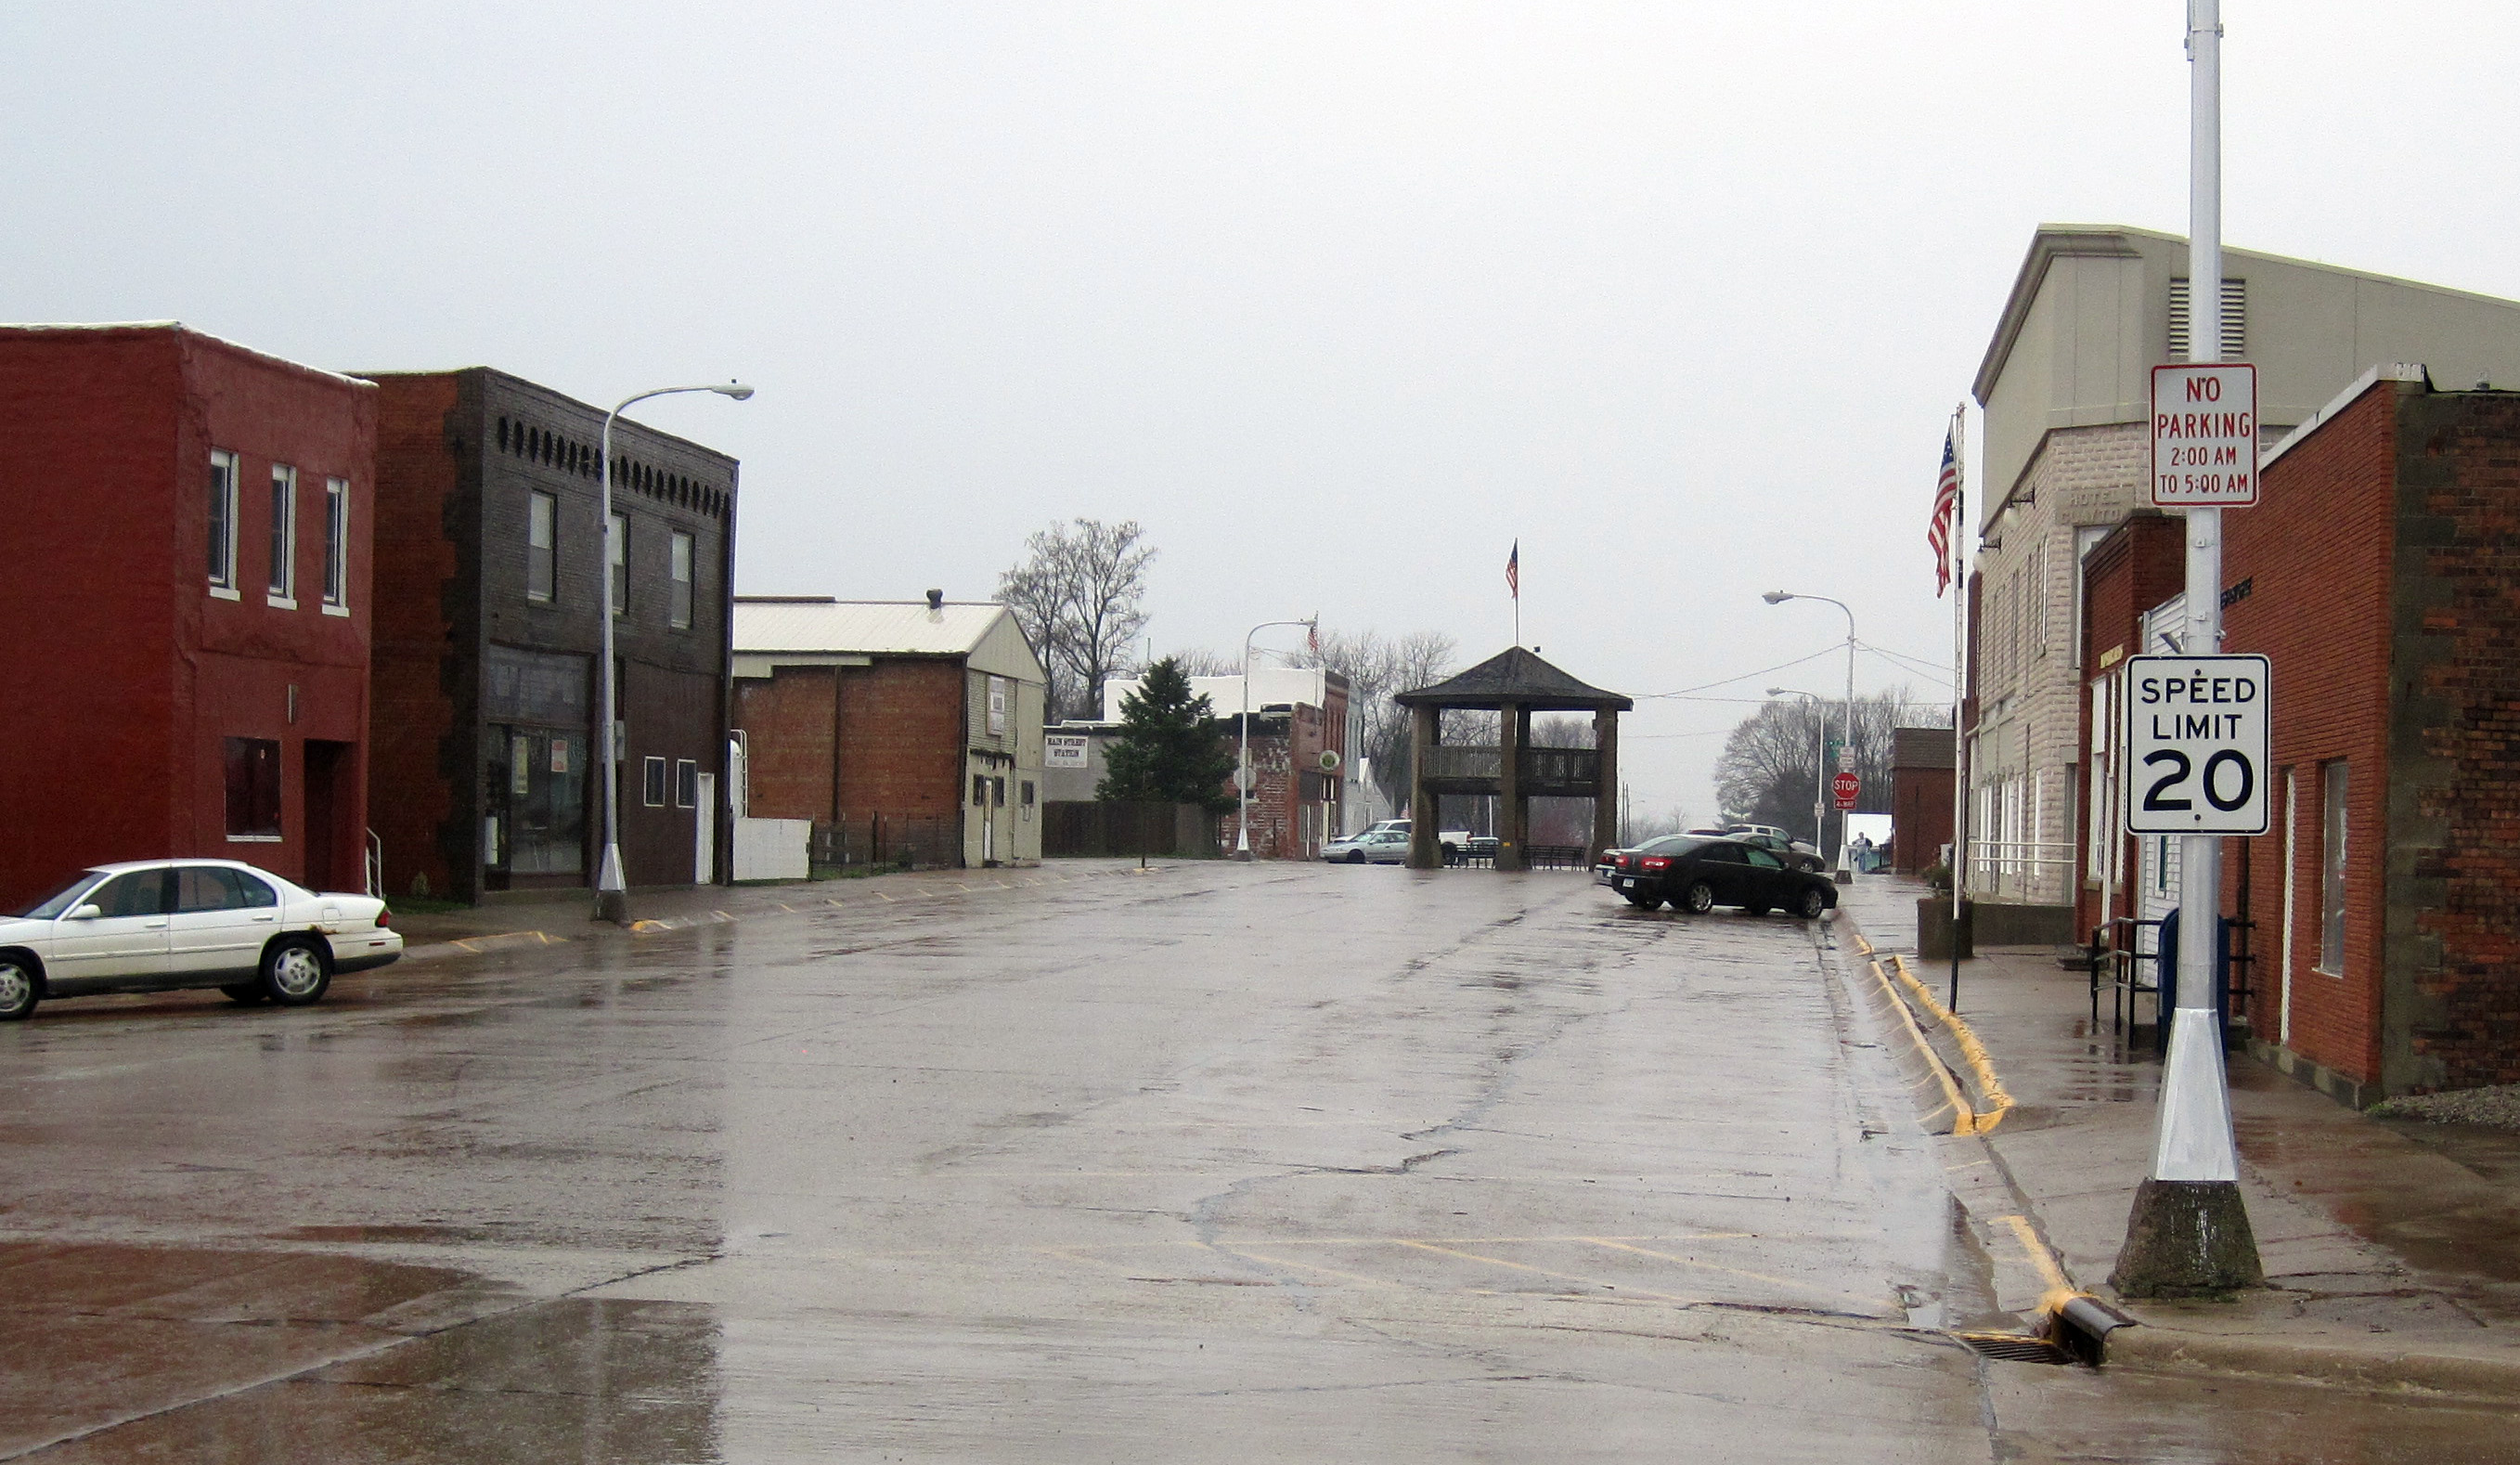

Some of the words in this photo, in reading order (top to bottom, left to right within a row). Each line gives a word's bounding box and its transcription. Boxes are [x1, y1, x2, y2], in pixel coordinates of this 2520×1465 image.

[2186, 376, 2221, 403] NO
[2157, 412, 2251, 439] PARKING
[2170, 447, 2208, 466] 2:00
[2214, 447, 2237, 465] AM
[2160, 473, 2178, 494] TO
[2185, 473, 2221, 494] 5:00
[2226, 473, 2248, 493] AM
[2140, 678, 2256, 704] SPEED
[2152, 714, 2243, 740] LIMIT
[1834, 780, 1858, 790] STOP
[2142, 748, 2255, 812] 20
